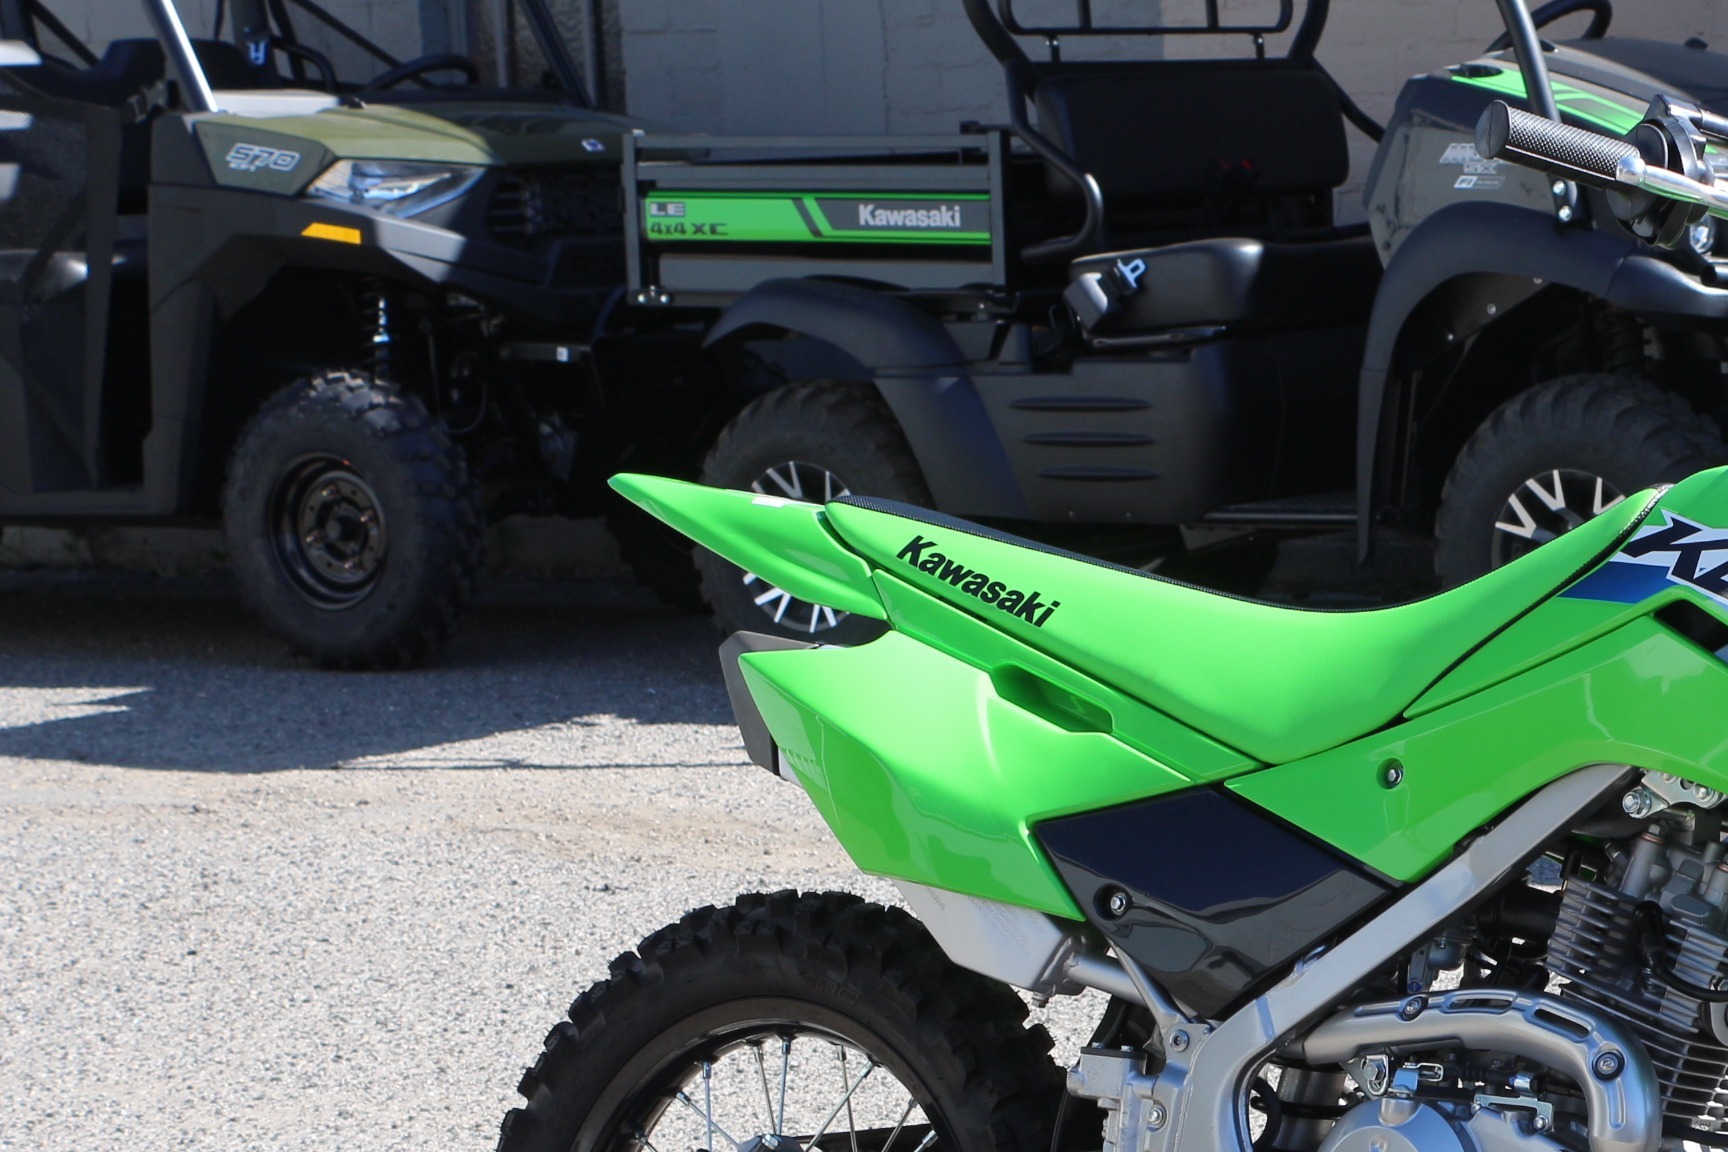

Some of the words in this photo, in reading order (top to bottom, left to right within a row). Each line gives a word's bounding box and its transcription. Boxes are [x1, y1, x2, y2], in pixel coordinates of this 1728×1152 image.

[226, 142, 301, 172] 570
[650, 202, 685, 216] LE
[858, 204, 961, 228] Kawasaki
[650, 222, 687, 236] 4x4
[691, 223, 728, 236] XC
[896, 534, 1062, 629] Kawasaki
